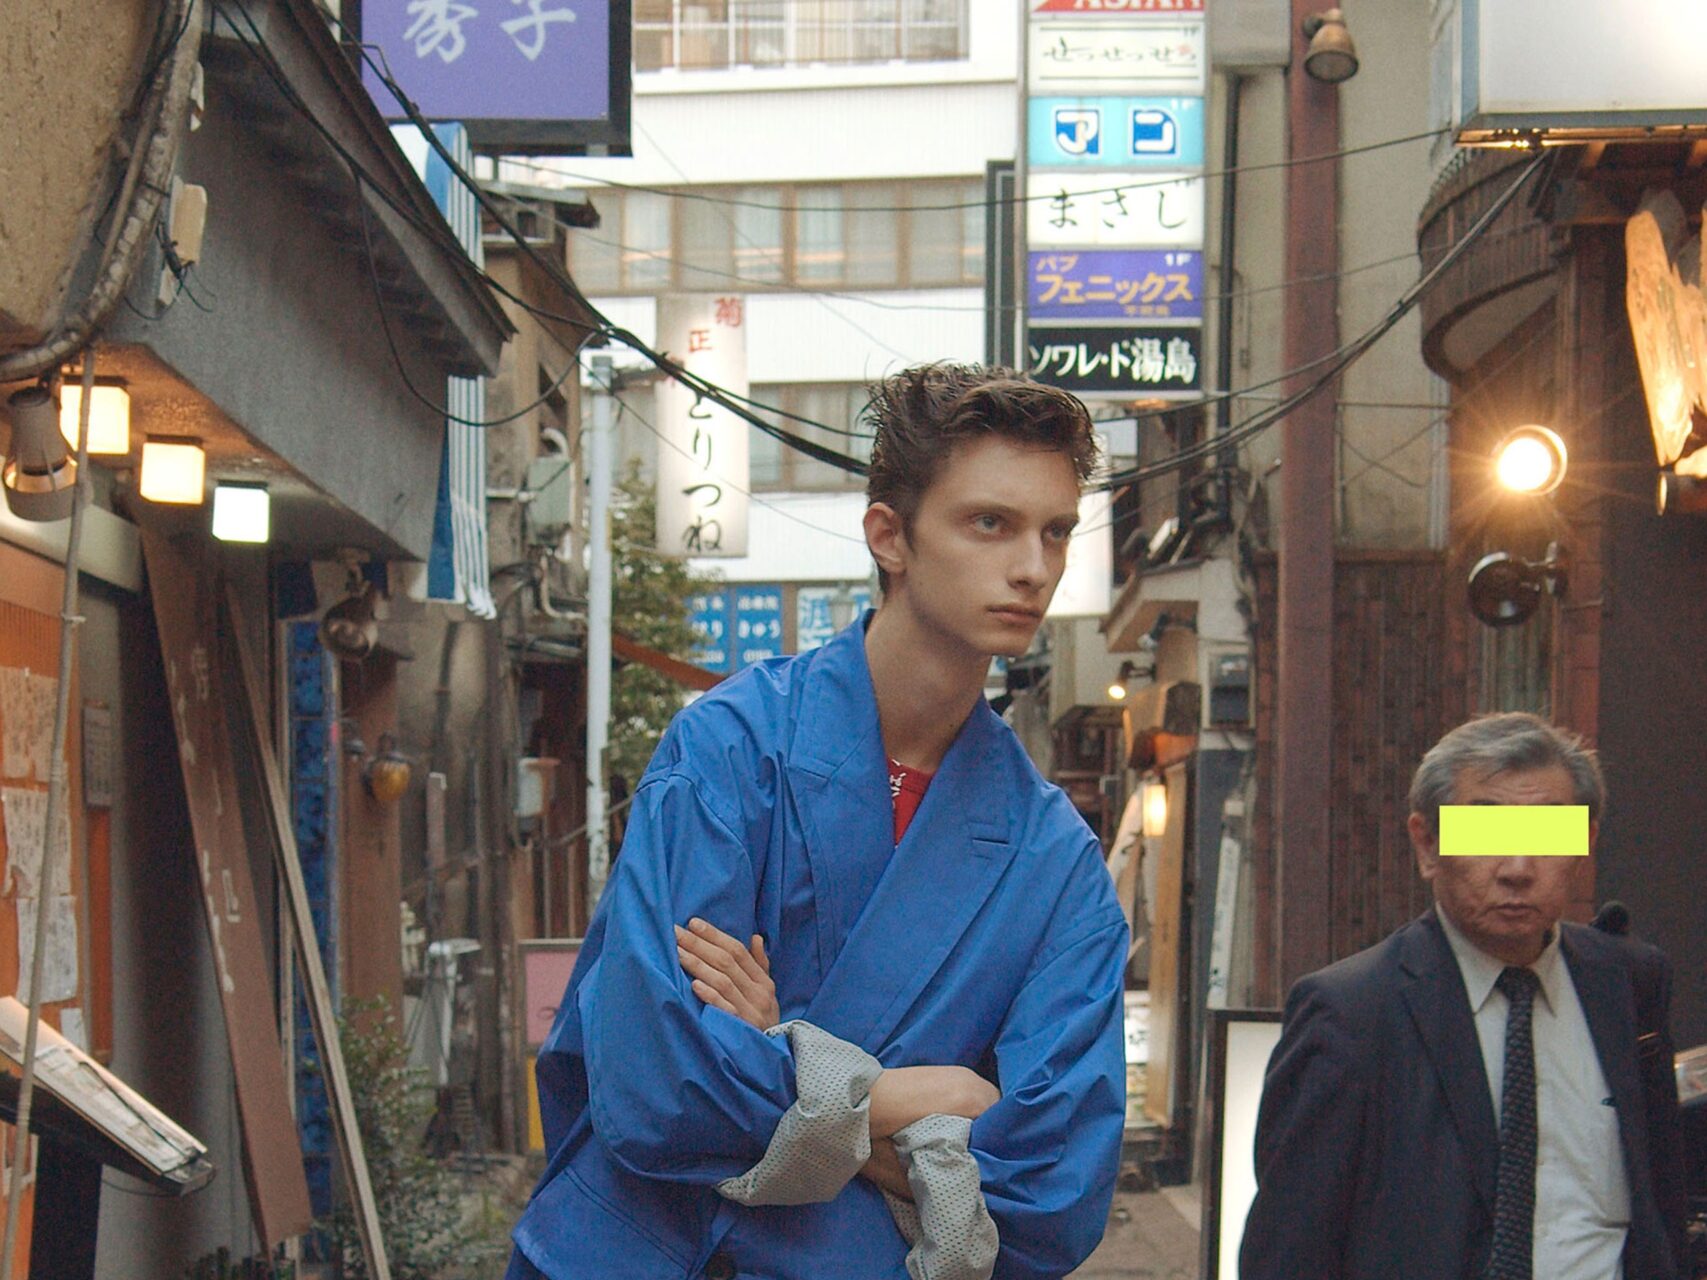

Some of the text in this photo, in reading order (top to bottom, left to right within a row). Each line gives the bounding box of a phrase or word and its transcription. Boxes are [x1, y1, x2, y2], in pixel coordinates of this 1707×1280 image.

[1165, 253, 1191, 266] 1F
[1036, 272, 1193, 304] フェニックス
[682, 392, 722, 551] とりつね
